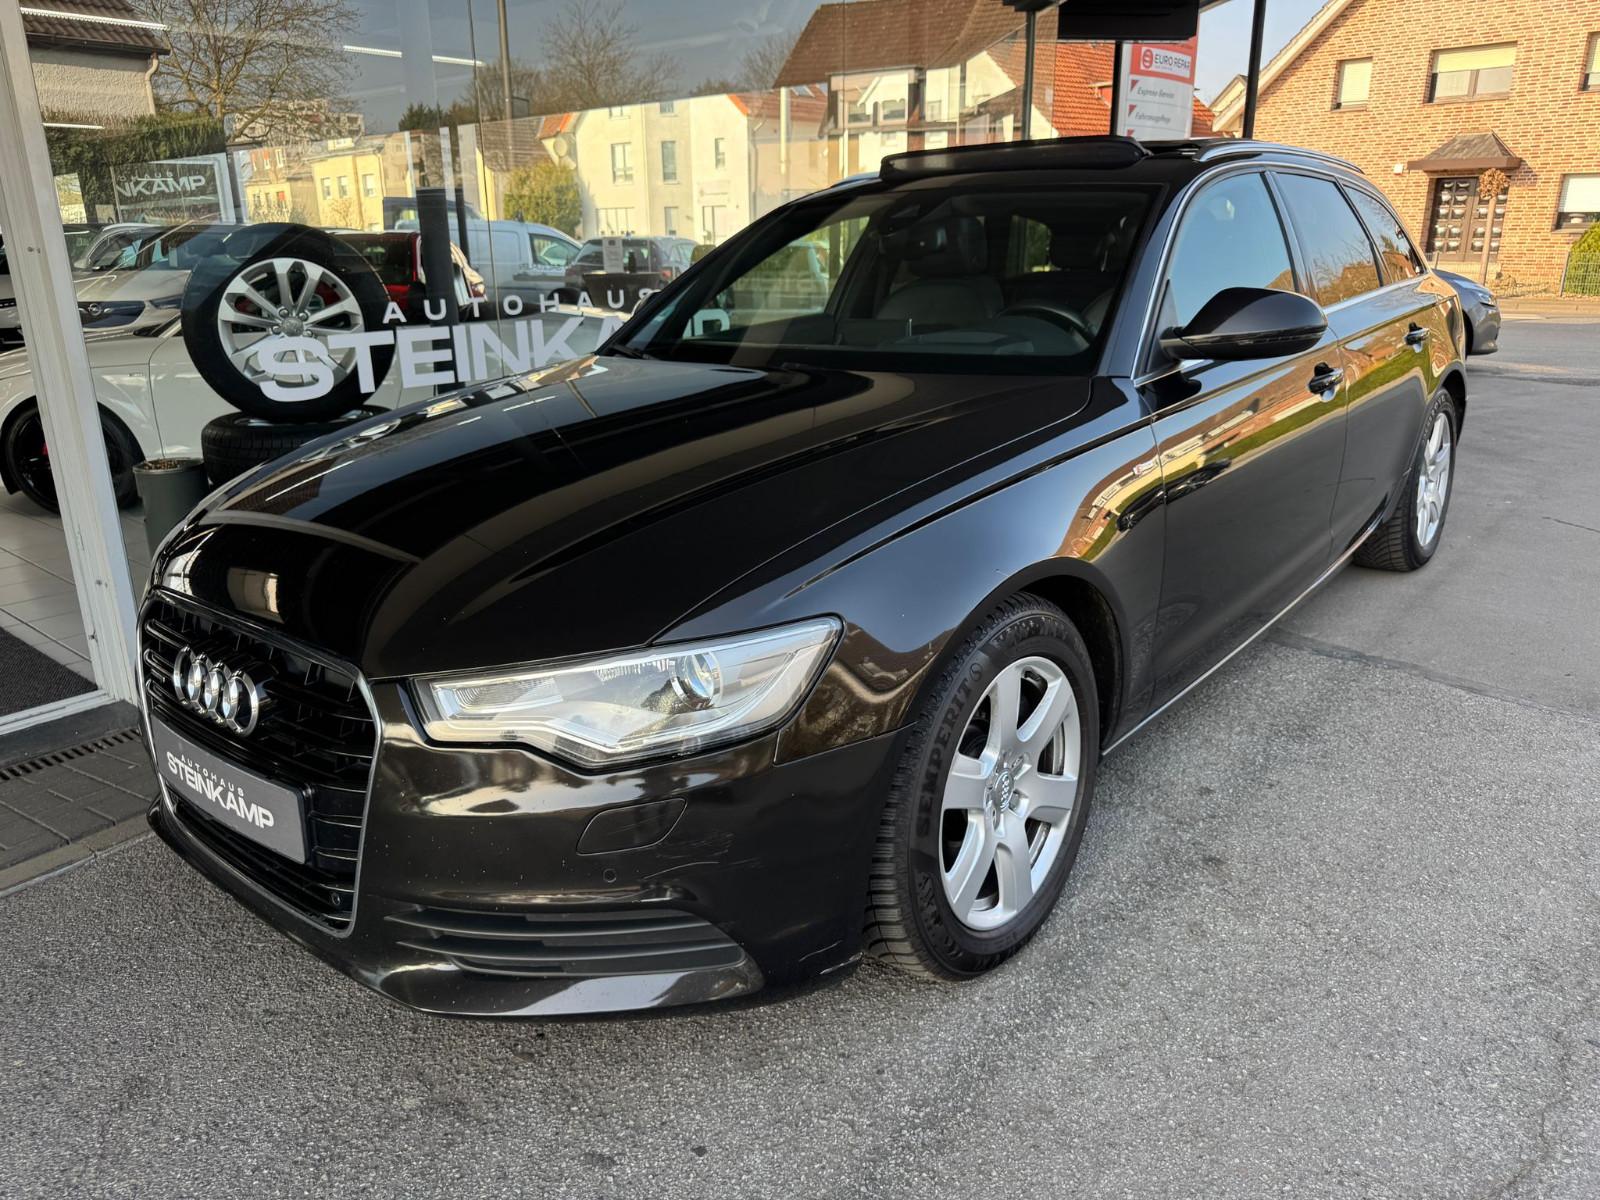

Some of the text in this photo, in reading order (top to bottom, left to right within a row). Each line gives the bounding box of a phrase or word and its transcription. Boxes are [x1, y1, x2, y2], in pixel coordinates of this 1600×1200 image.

[1154, 53, 1173, 66] EURO
[258, 309, 730, 402] STEINKAP
[166, 751, 275, 829] STEINKAMP
[180, 754, 245, 797] AUTOHAUS
[915, 678, 973, 838] SEMPERIT
